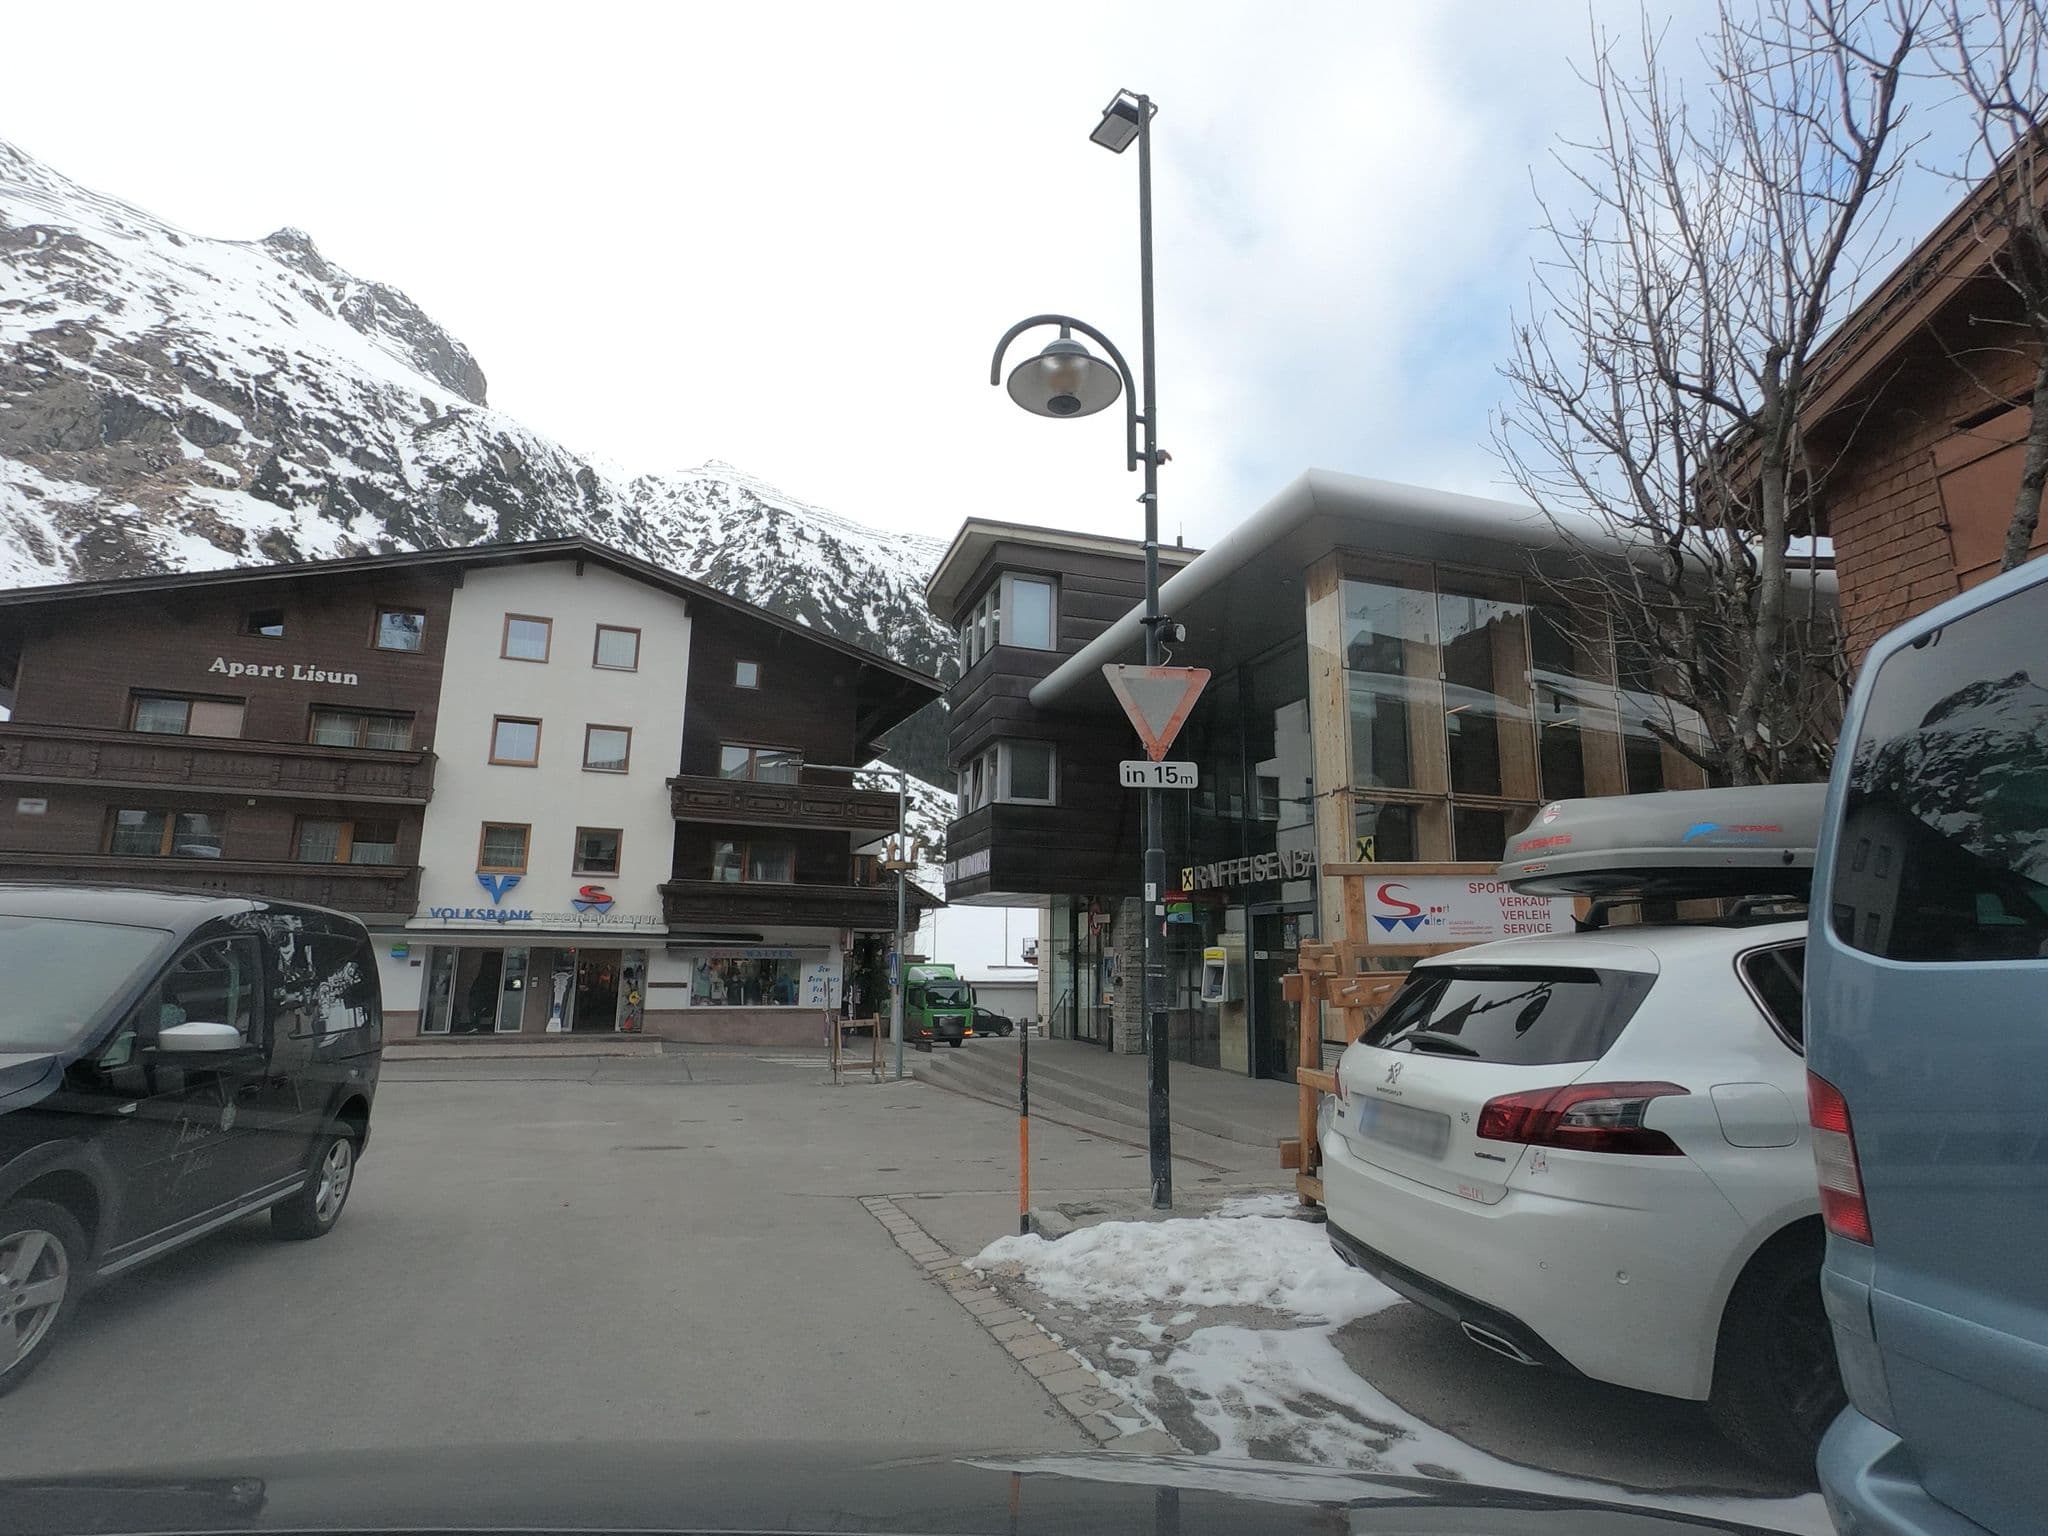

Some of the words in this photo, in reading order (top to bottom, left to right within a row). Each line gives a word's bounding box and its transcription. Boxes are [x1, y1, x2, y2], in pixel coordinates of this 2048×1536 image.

[208, 656, 285, 678] Apart
[292, 664, 358, 686] Lisun
[1126, 765, 1145, 783] in
[1154, 766, 1193, 785] 15m
[1499, 896, 1552, 907] VERKAUF
[430, 907, 534, 921] VOLKSBANK
[1501, 910, 1551, 920] VERLEIH
[1503, 923, 1553, 934] SERVICE
